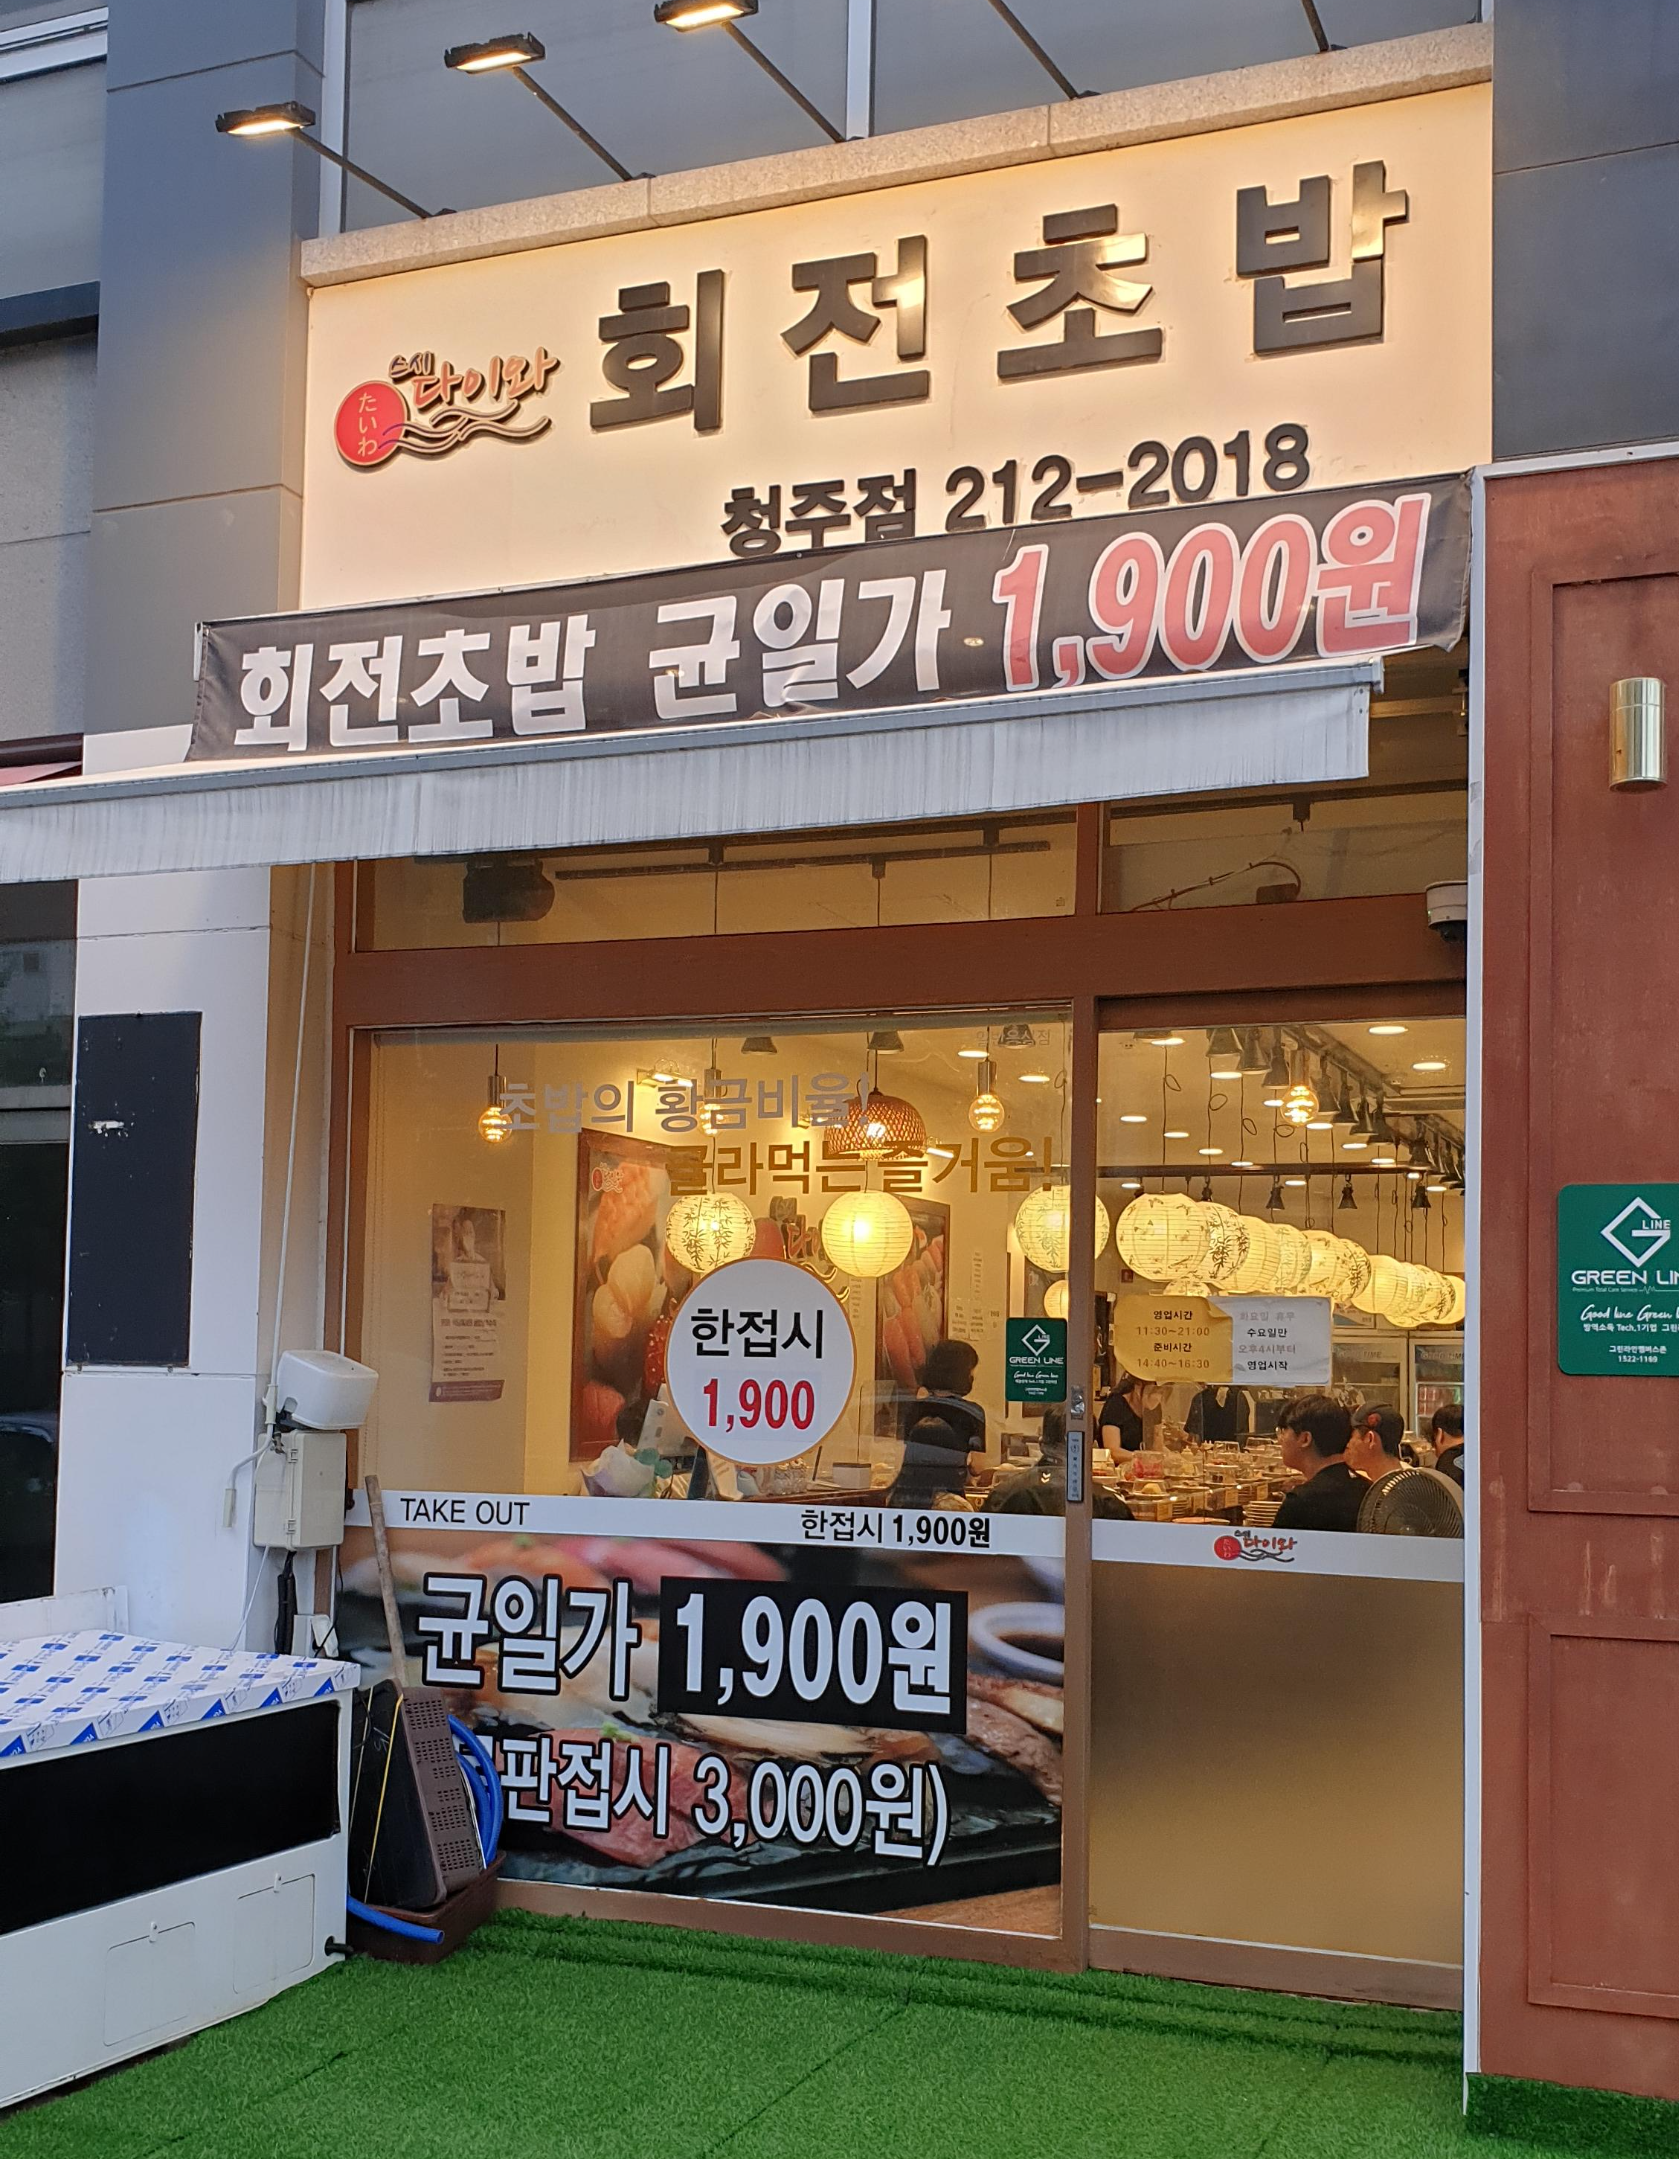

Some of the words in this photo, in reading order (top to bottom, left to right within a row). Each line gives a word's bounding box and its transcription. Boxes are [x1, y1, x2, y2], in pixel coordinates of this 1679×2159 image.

[590, 160, 1408, 433] 회전초밥
[357, 391, 380, 458] たいわ
[721, 467, 917, 558] 청주점
[945, 422, 1311, 533] 212-2018
[233, 613, 596, 752] 회전초밥
[648, 568, 952, 720] 균일가
[992, 492, 1433, 692] 1,900원
[499, 1079, 635, 1134] 초밥의
[654, 1071, 870, 1134] 황금비율!
[1642, 1219, 1671, 1230] LINE
[1571, 1269, 1648, 1286] GREEN
[1153, 1309, 1194, 1321] 영업시간
[1580, 1303, 1611, 1322] Good
[1636, 1303, 1673, 1322] Green
[690, 1307, 824, 1360] 한접시
[1136, 1326, 1211, 1337] 11:30~21:00
[1153, 1341, 1193, 1353] 준비시간
[1246, 1327, 1289, 1338] 수요일만
[1008, 1356, 1041, 1365] GREEN
[1043, 1356, 1065, 1365] LINE
[1246, 1359, 1289, 1371] 영업시작
[703, 1378, 815, 1433] 1,900
[400, 1497, 466, 1523] TAKE
[475, 1499, 531, 1526] OUT
[800, 1509, 883, 1544] 한접시
[893, 1514, 990, 1549] 1,900원
[418, 1571, 639, 1698] 균일가
[676, 1592, 952, 1715] 1,900원
[694, 1755, 950, 1865] 3,000원)
